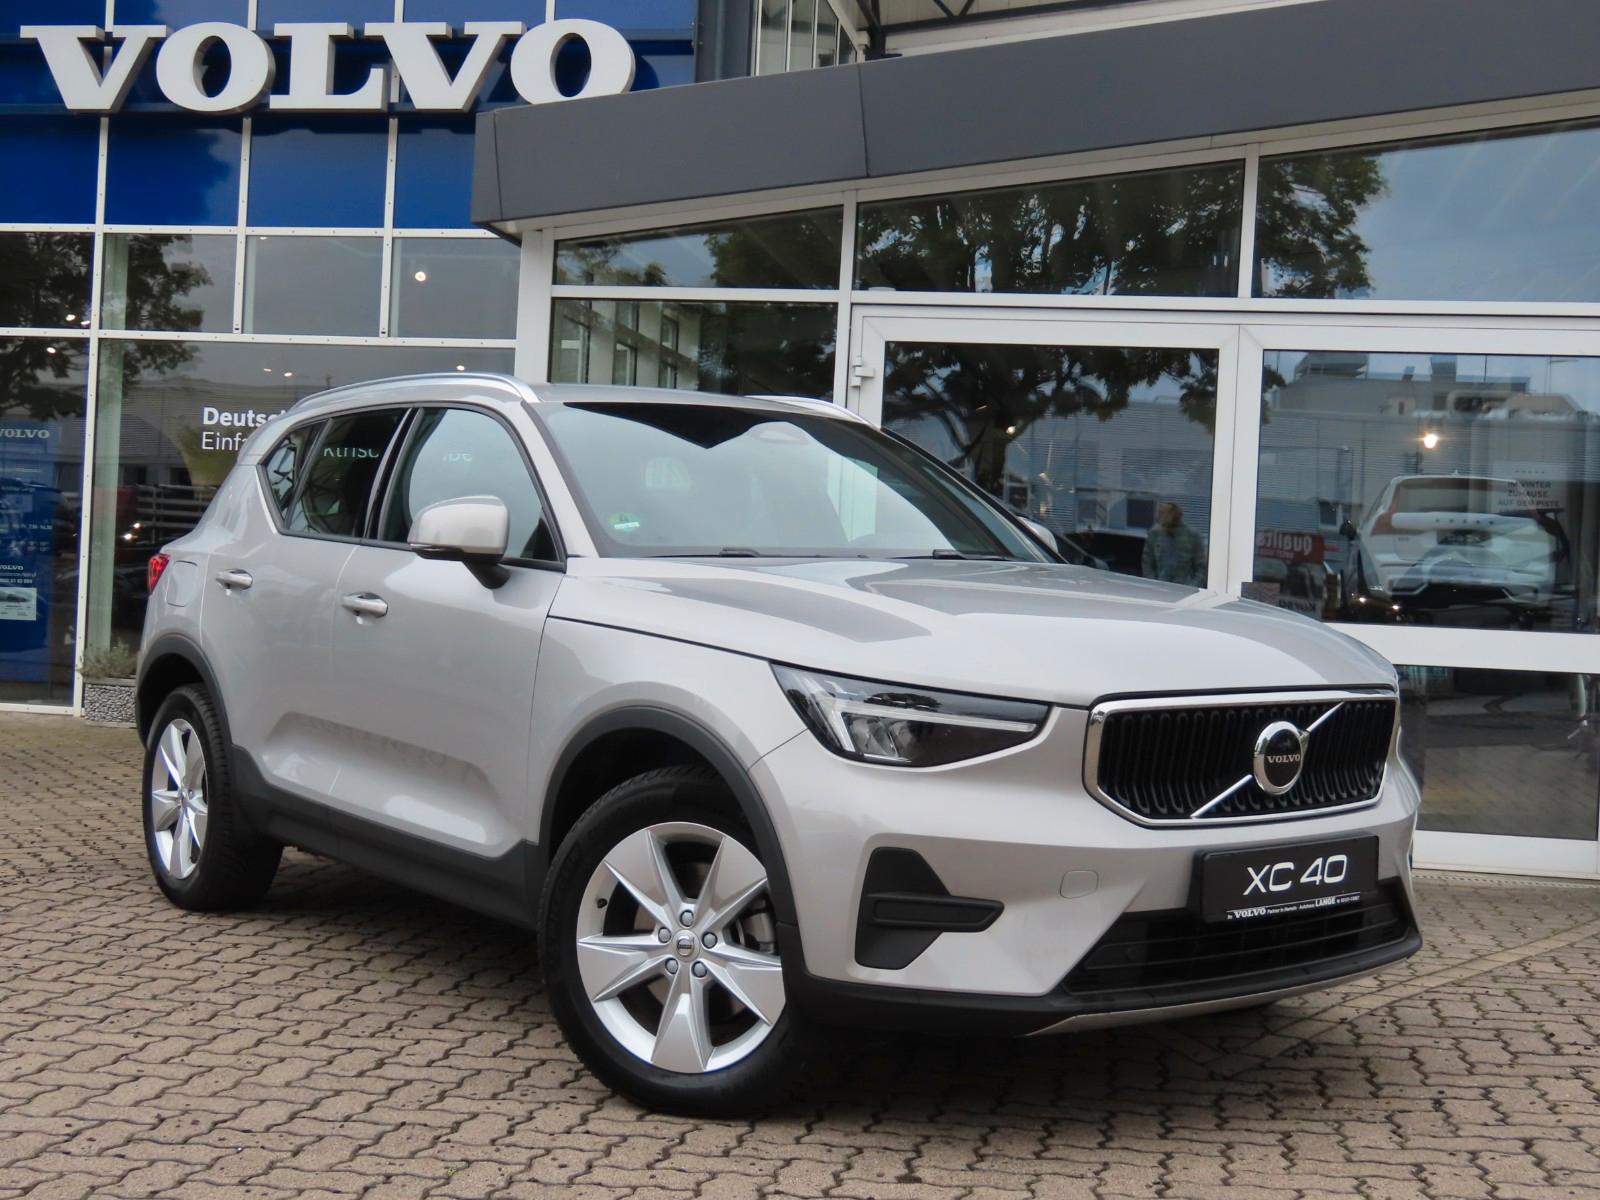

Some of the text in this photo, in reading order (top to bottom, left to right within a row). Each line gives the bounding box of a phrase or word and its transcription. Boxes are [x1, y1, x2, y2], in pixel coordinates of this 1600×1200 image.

[20, 19, 637, 112] VOLVO
[1267, 754, 1301, 763] VOLVO
[1242, 854, 1348, 895] XC 40
[1234, 907, 1267, 919] VOLVO
